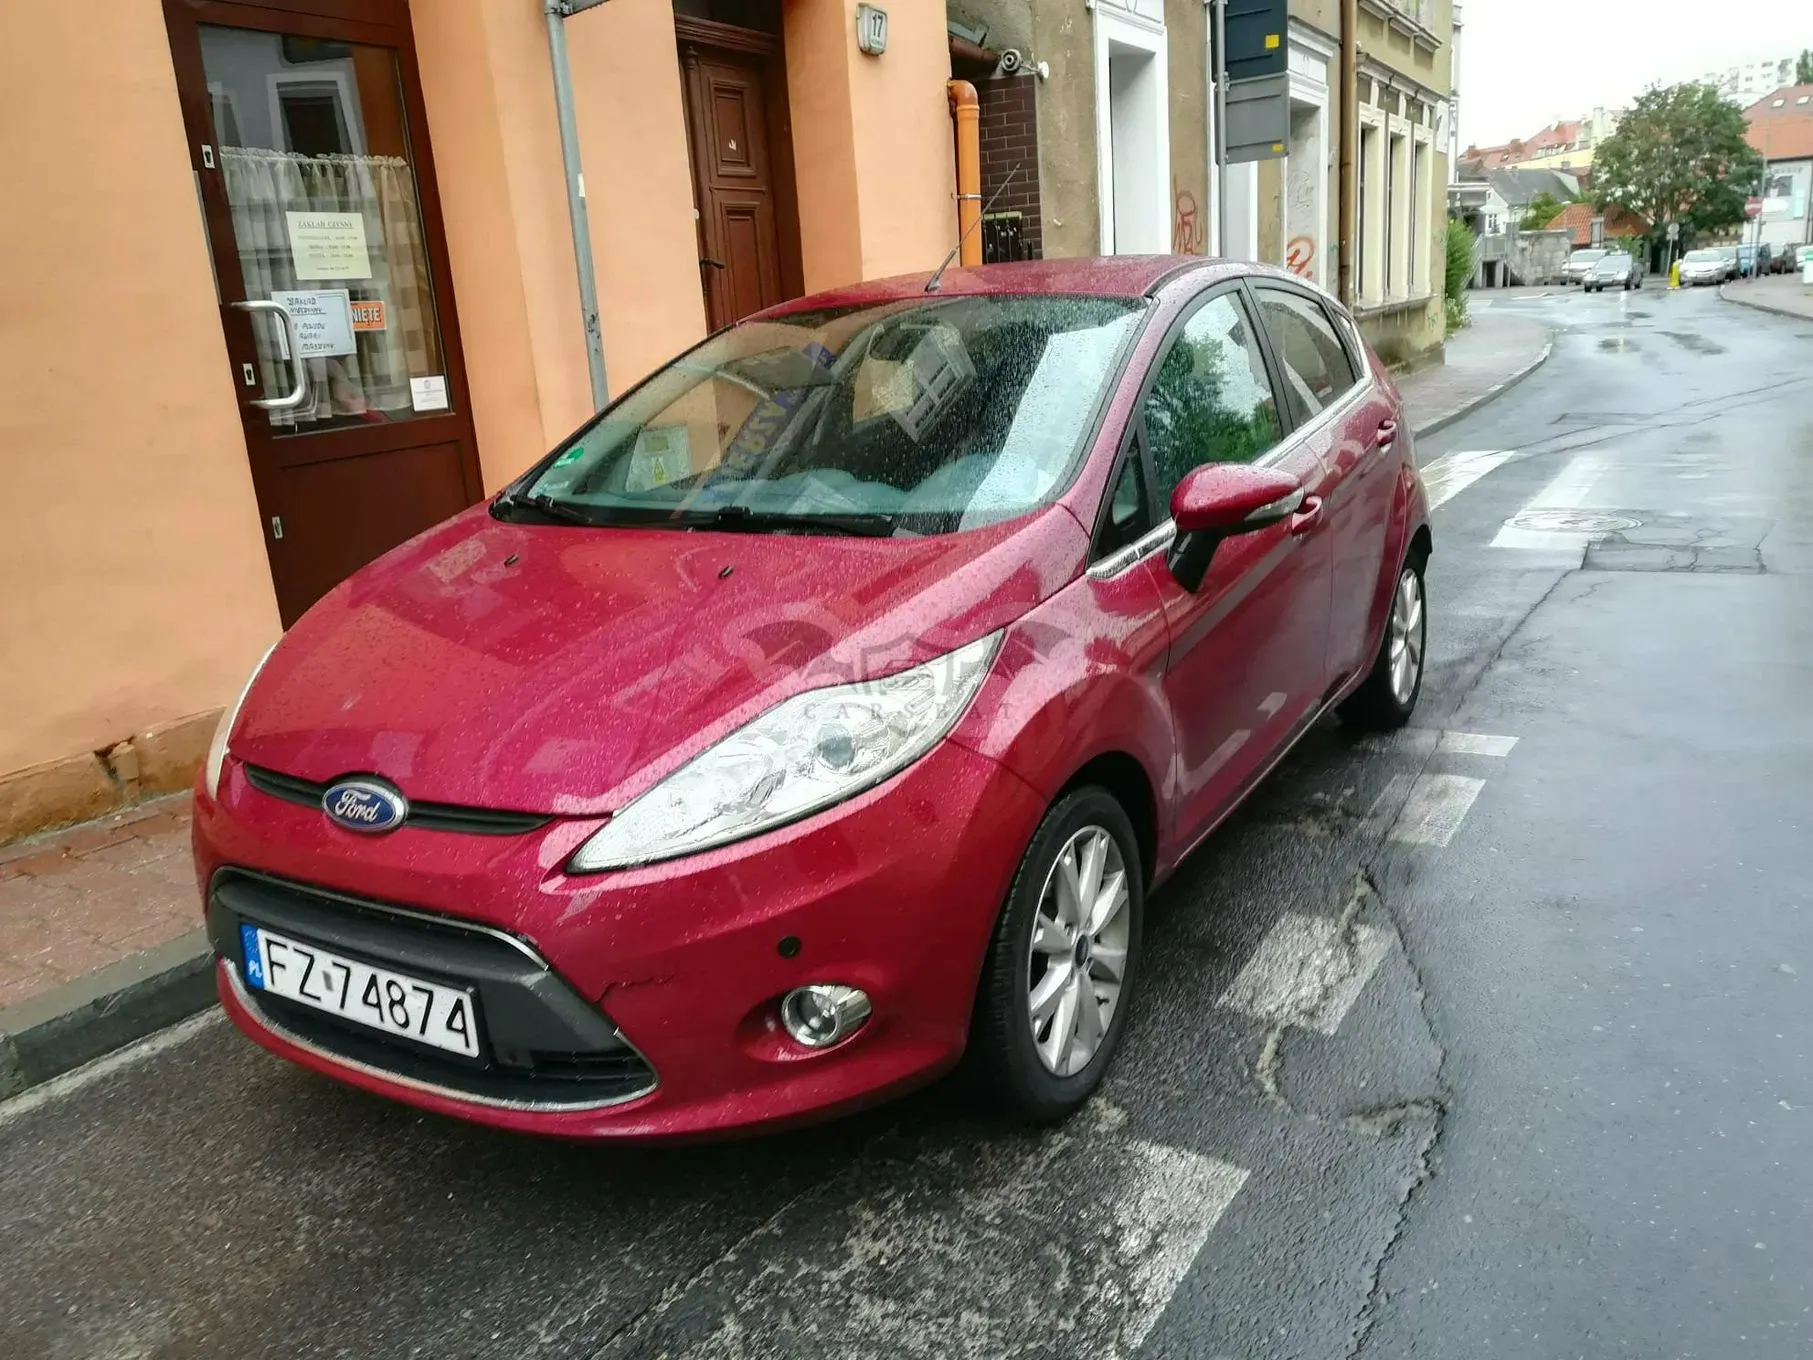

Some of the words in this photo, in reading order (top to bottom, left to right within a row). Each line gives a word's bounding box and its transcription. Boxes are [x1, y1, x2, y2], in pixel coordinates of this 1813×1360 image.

[872, 13, 884, 38] 17
[334, 788, 380, 824] Ford
[248, 960, 263, 979] PL
